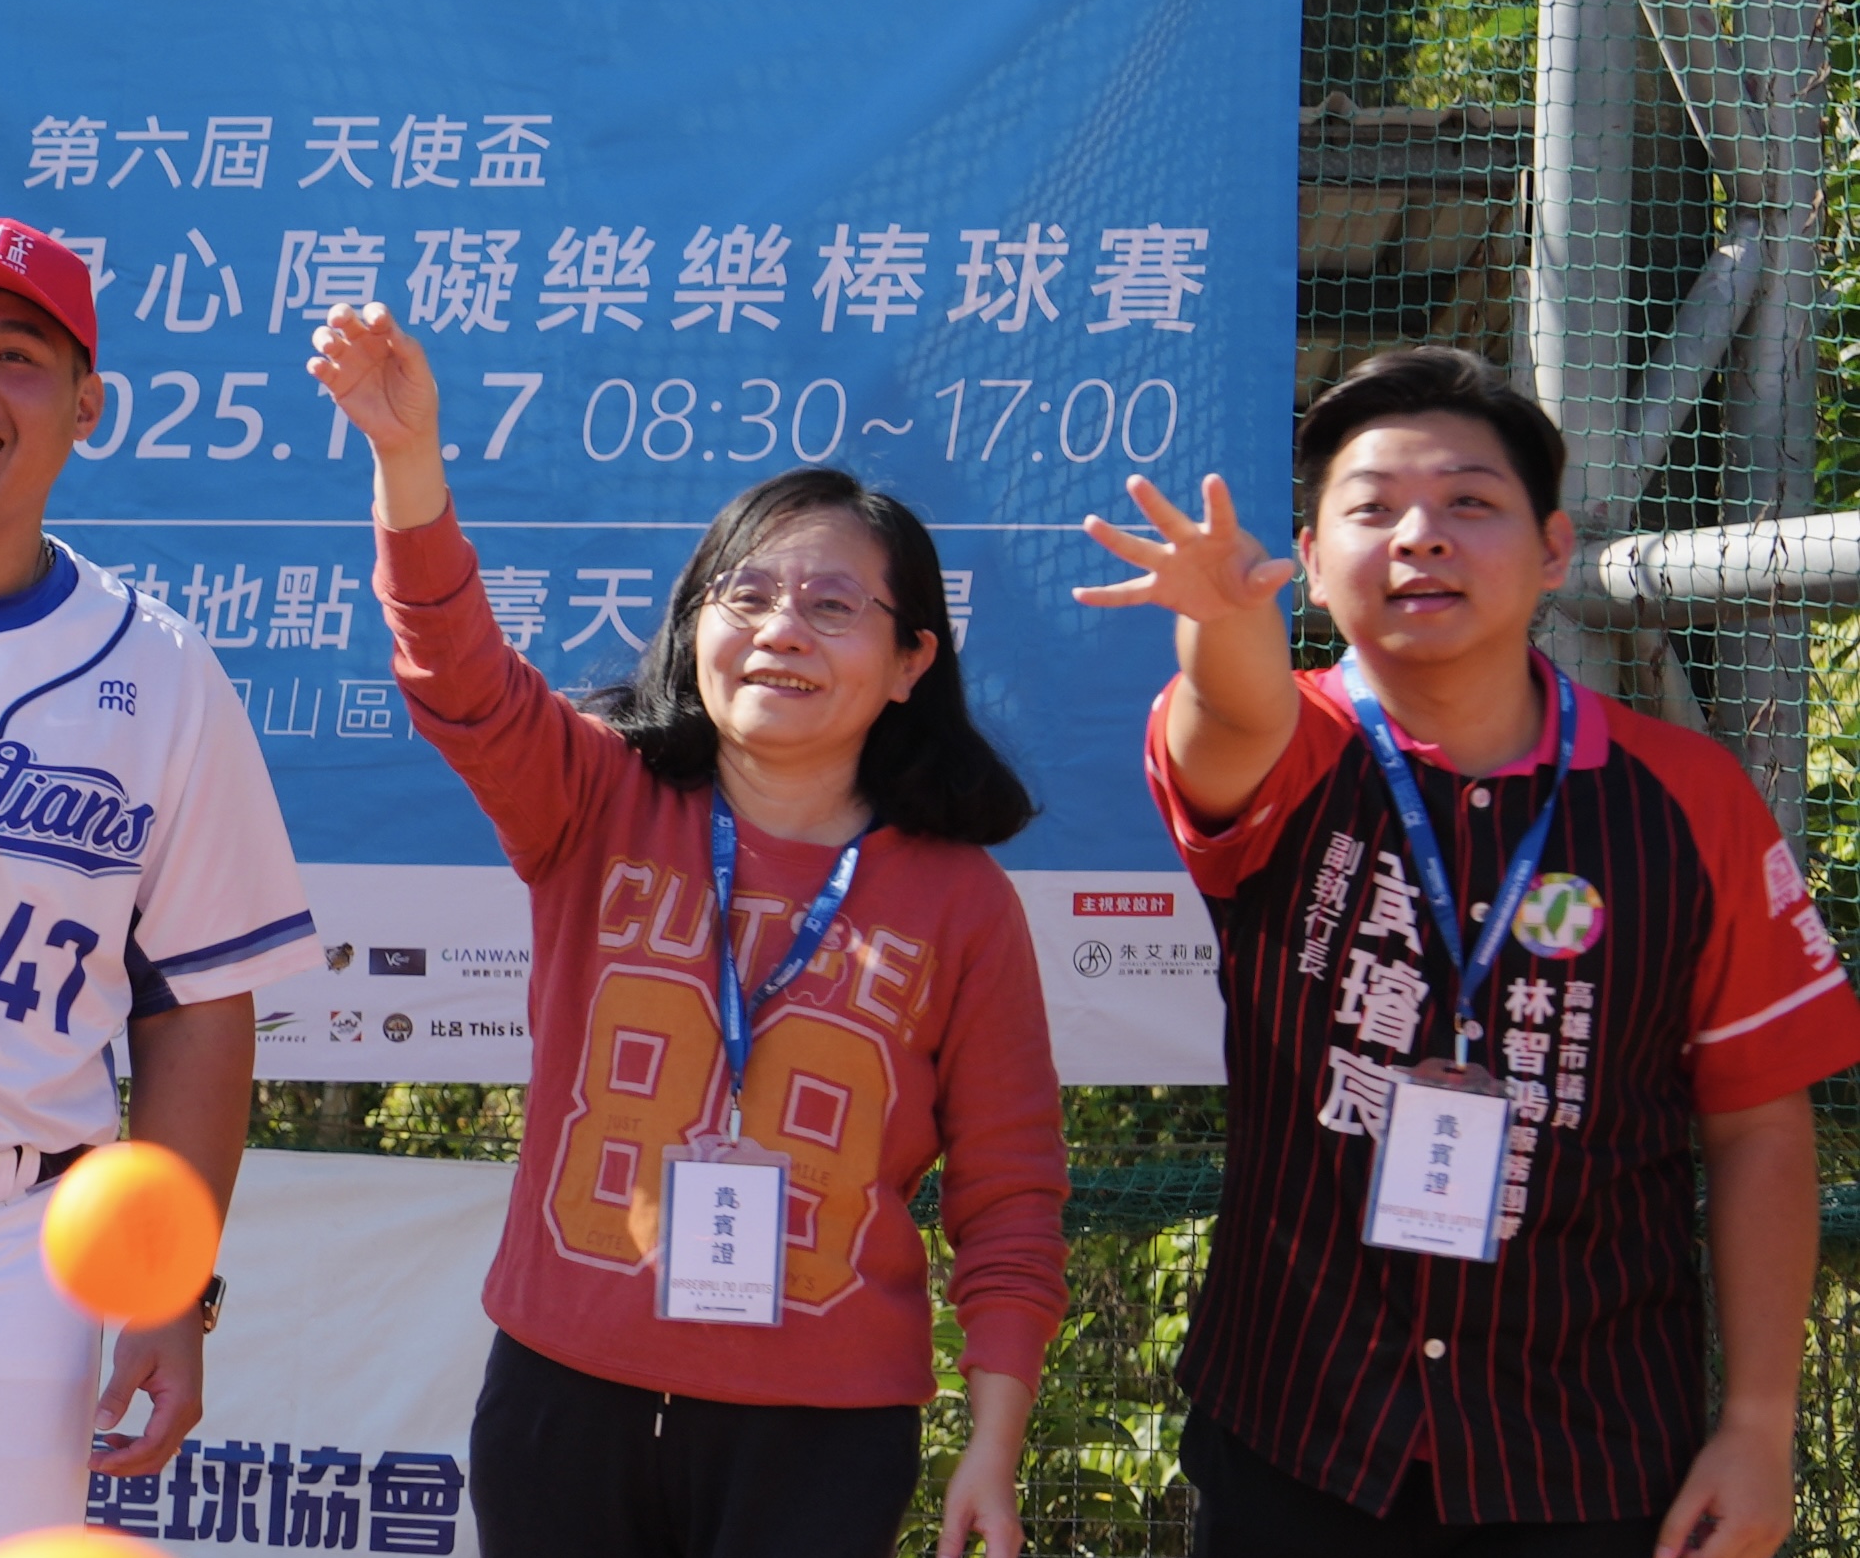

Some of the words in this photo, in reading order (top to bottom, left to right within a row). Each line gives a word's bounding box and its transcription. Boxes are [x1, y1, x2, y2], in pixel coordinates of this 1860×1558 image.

[24, 114, 273, 190] 第六屆
[297, 114, 552, 190] 天使盃
[582, 377, 1179, 464] 08:30~17:00
[1081, 896, 1166, 913] 主視覺設計
[1298, 830, 1366, 981] 副執行長
[432, 1020, 463, 1038] 比呂
[469, 1021, 505, 1037] This
[510, 1022, 524, 1037] is
[1551, 979, 1596, 1130] 高雄市議員
[1423, 1113, 1458, 1196] 貴賓證
[712, 1186, 737, 1265] 貴賓證
